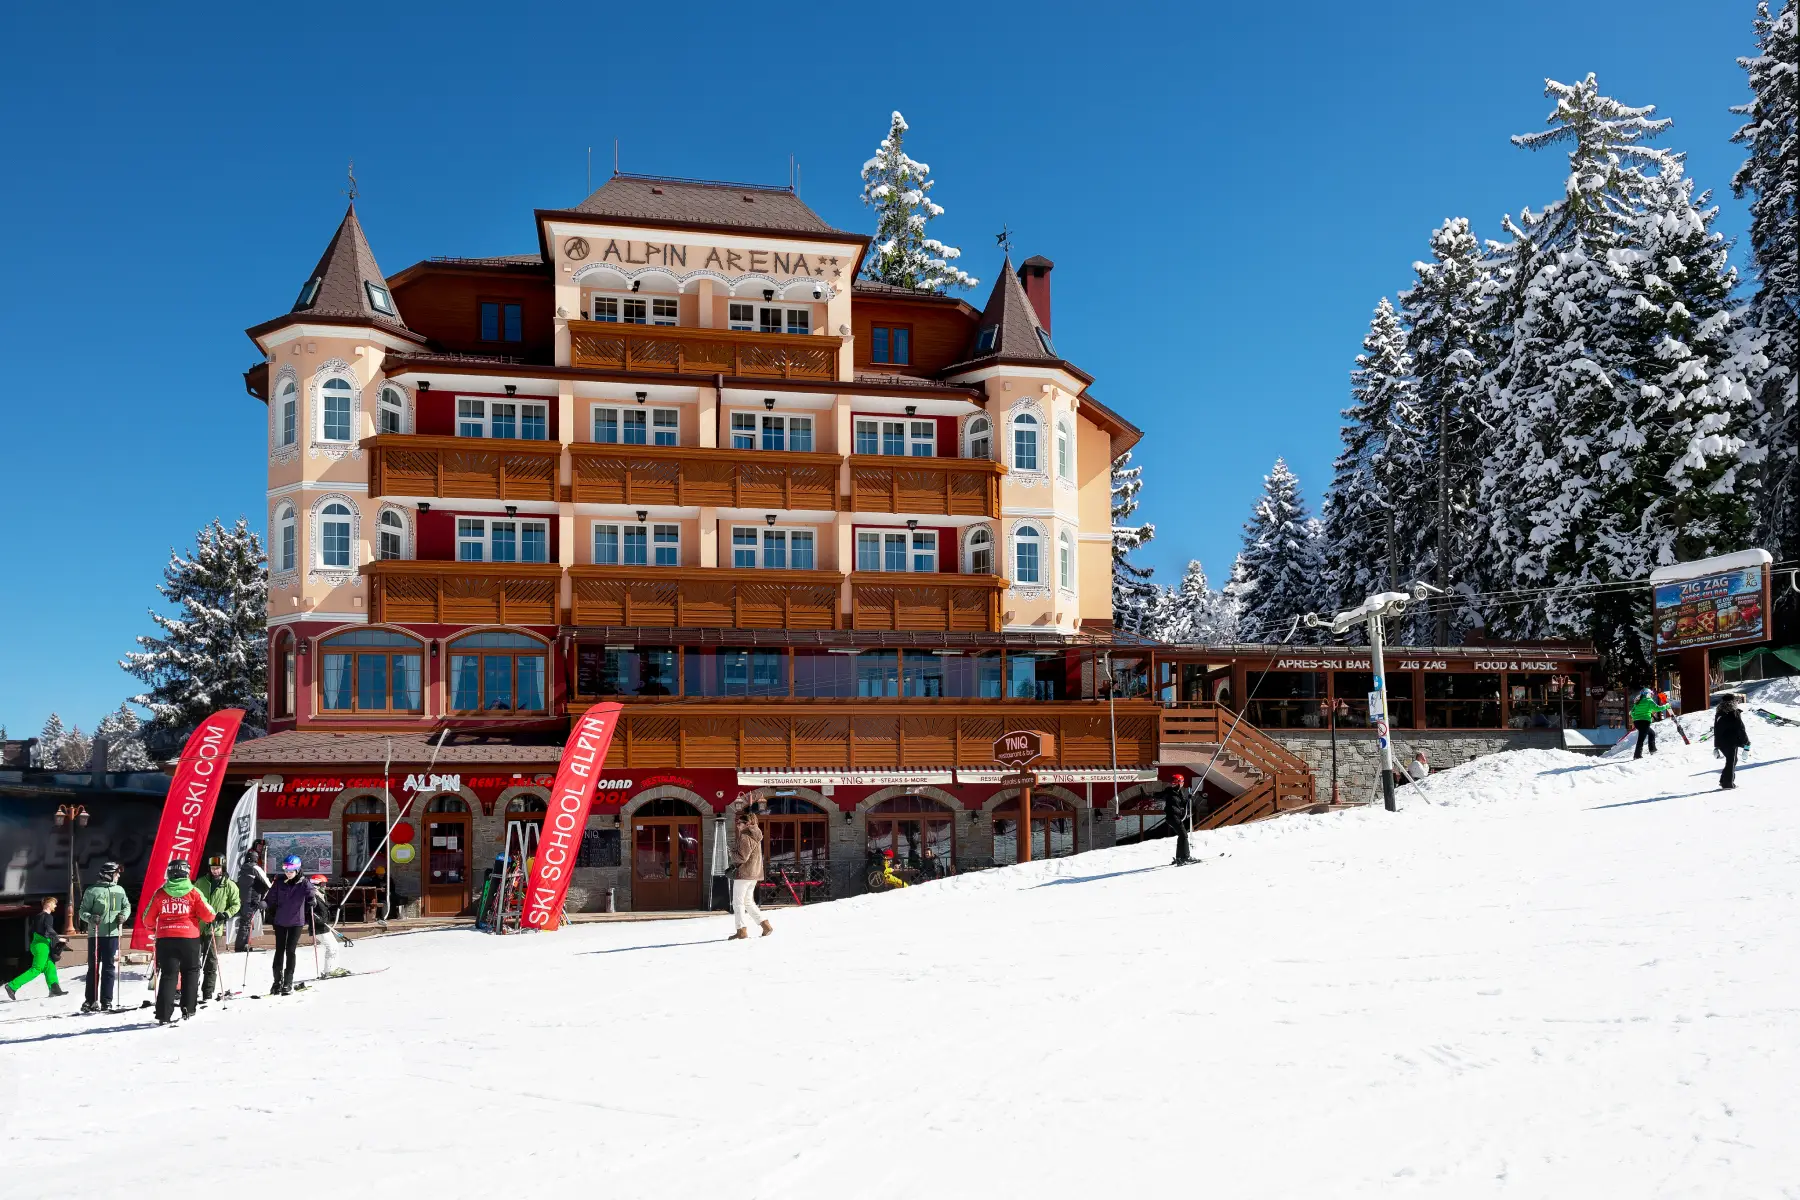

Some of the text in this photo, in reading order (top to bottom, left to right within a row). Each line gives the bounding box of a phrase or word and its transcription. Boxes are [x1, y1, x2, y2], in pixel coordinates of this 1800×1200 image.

[602, 239, 811, 276] ALPIN ARENA
[1681, 577, 1728, 594] ZIG ZAG
[1345, 660, 1371, 669] BAR
[1400, 660, 1447, 669] ZIG ZAG
[1475, 661, 1558, 670] FOOD & MUSIC
[1005, 735, 1029, 751] YNIQ
[403, 774, 461, 792] ALPIN
[597, 779, 633, 789] OARD
[841, 777, 864, 785] YNIQ
[1053, 775, 1075, 783] YNIQ
[260, 782, 284, 792] SKI
[164, 725, 225, 880] ENT-SKI.COM
[528, 717, 605, 926] SKI SCHOOL ALPIN
[584, 830, 600, 839] NIQ
[161, 902, 189, 914] ALPIN
